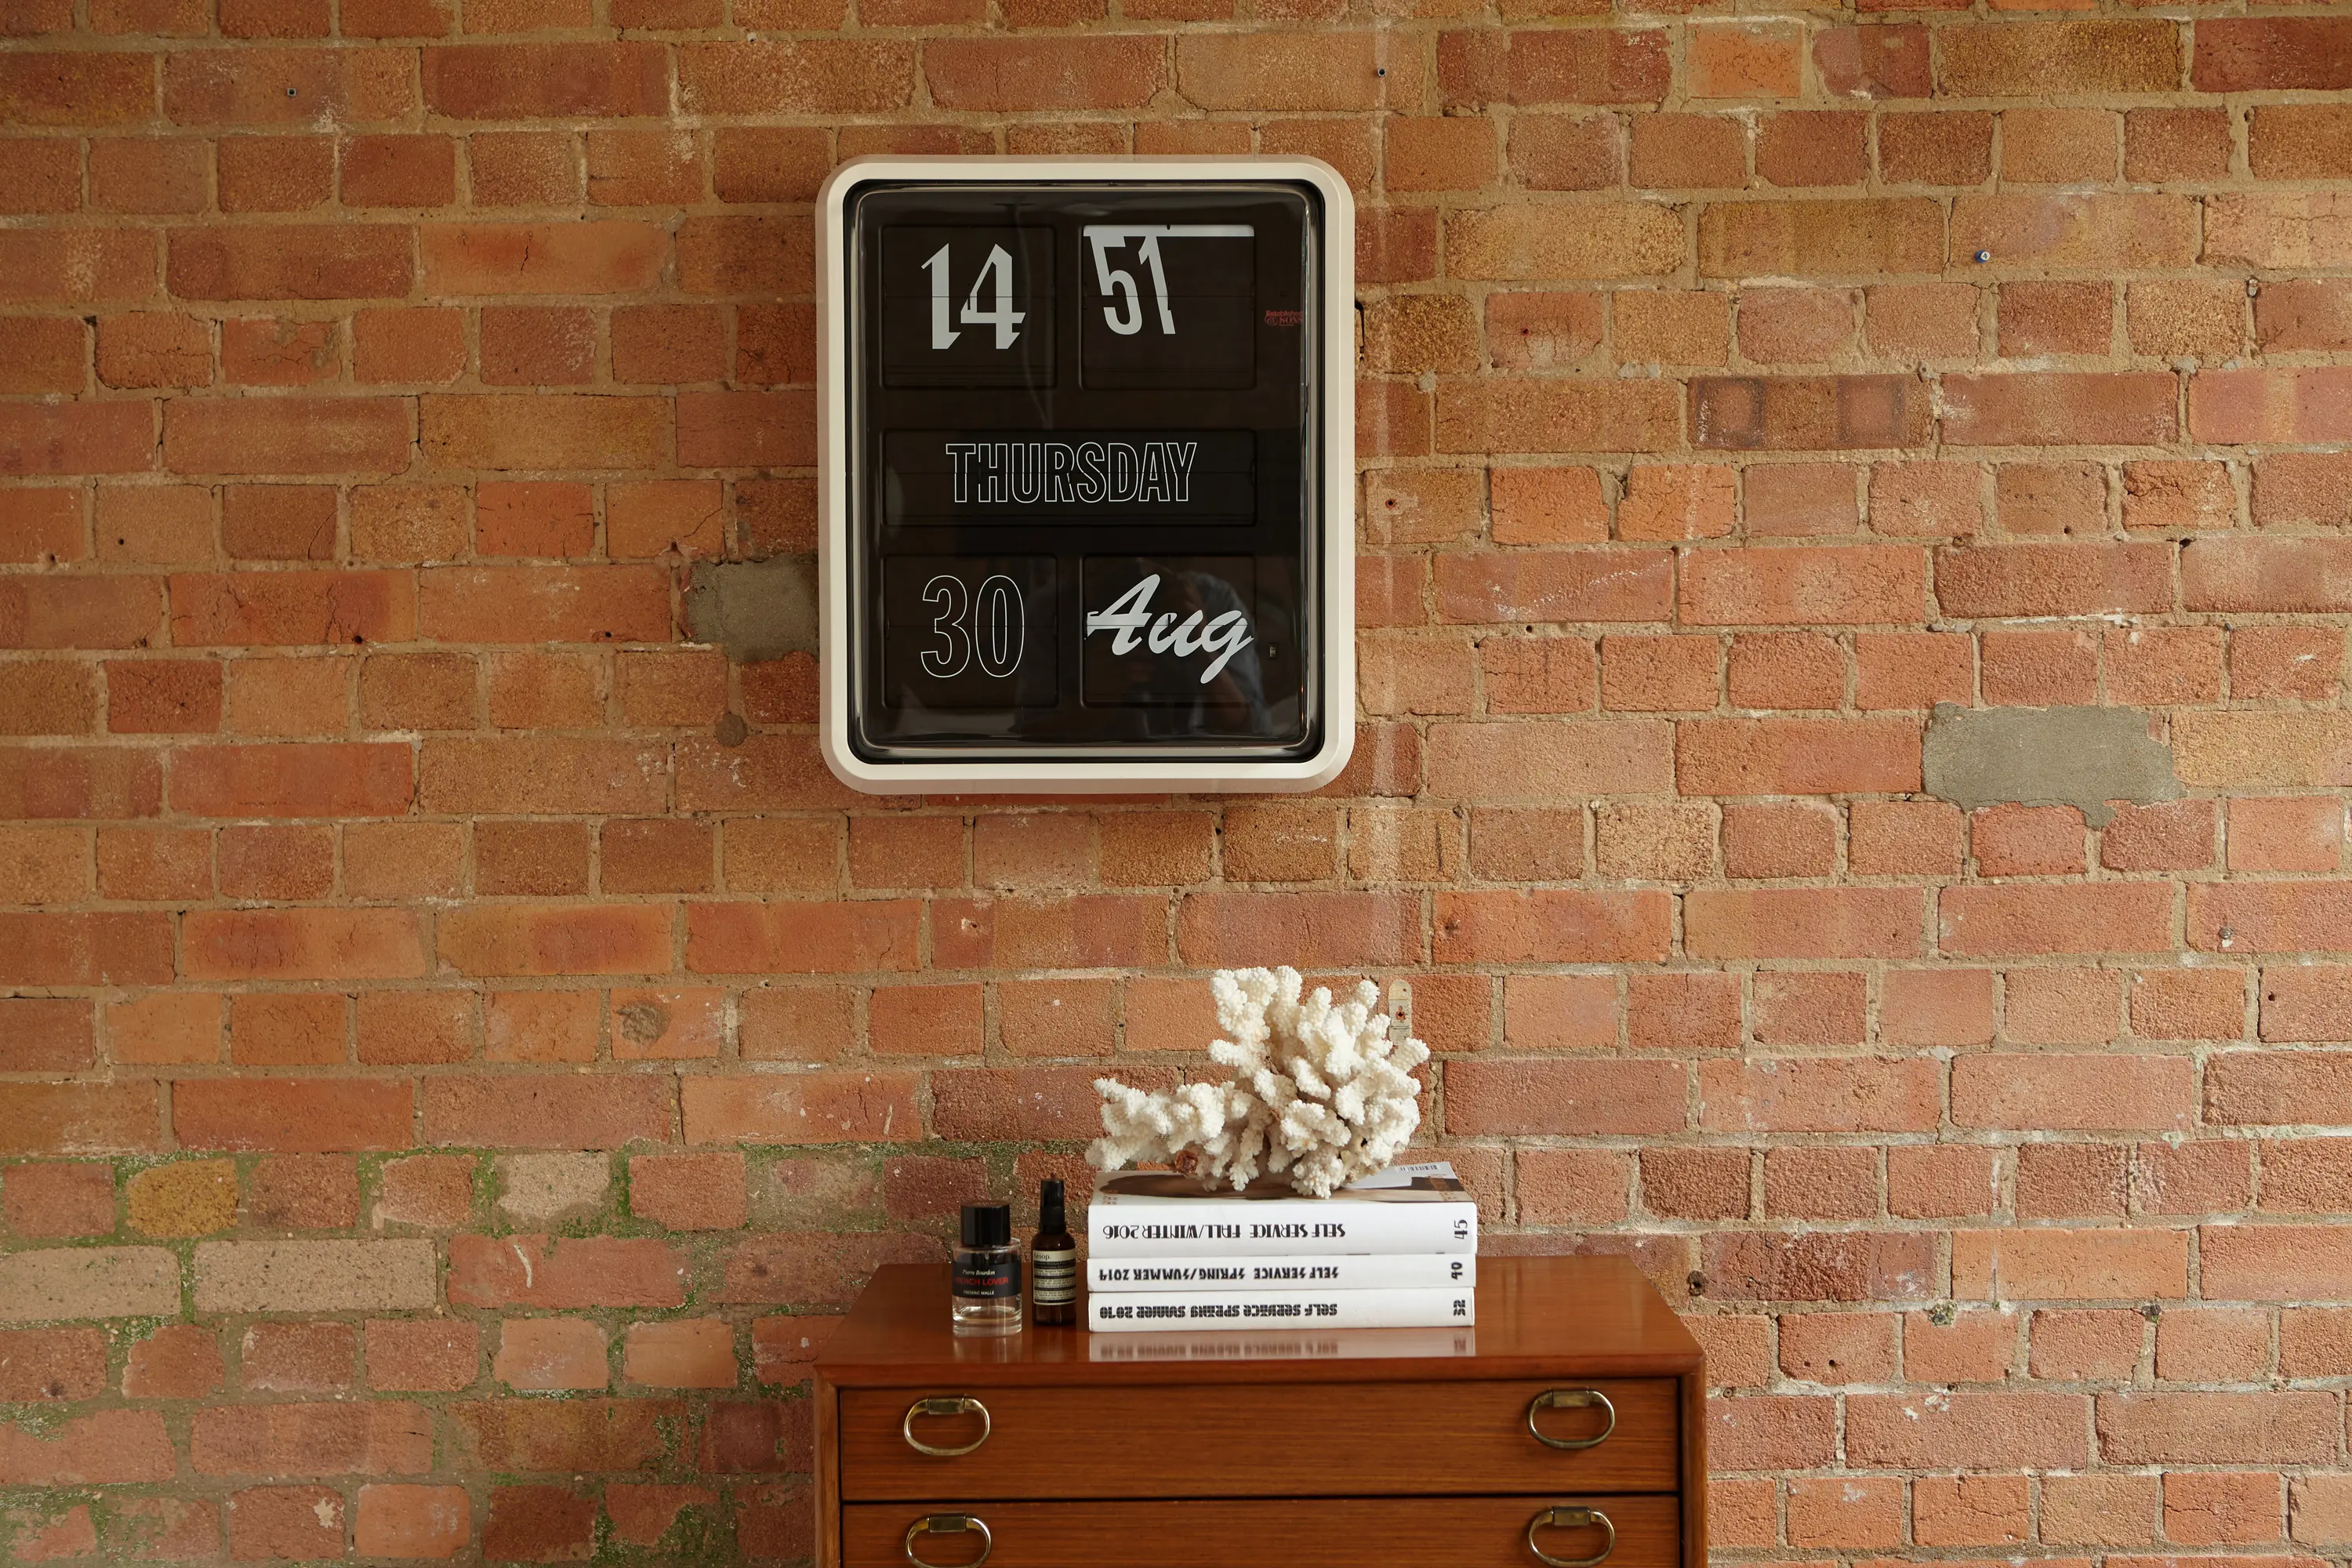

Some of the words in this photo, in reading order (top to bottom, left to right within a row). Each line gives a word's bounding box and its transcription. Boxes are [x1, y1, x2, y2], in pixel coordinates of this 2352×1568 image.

[1089, 235, 1175, 335] 51
[921, 243, 1025, 349] 14
[946, 441, 1197, 503] THURSDAY
[920, 575, 1025, 677] 30
[1087, 573, 1254, 684] Aug
[1102, 1225, 1139, 1240] 2016
[1142, 1225, 1241, 1239] FALL/WINTER
[1250, 1224, 1308, 1238] SERVICE
[1312, 1224, 1345, 1238] SELF
[1454, 1219, 1468, 1240] 45
[1099, 1269, 1130, 1281] 2014
[1254, 1266, 1306, 1279] SERVICE
[1308, 1266, 1339, 1279] SELF
[1451, 1261, 1463, 1280] 40
[982, 1276, 1009, 1286] LOVER
[1099, 1306, 1133, 1319] 2010
